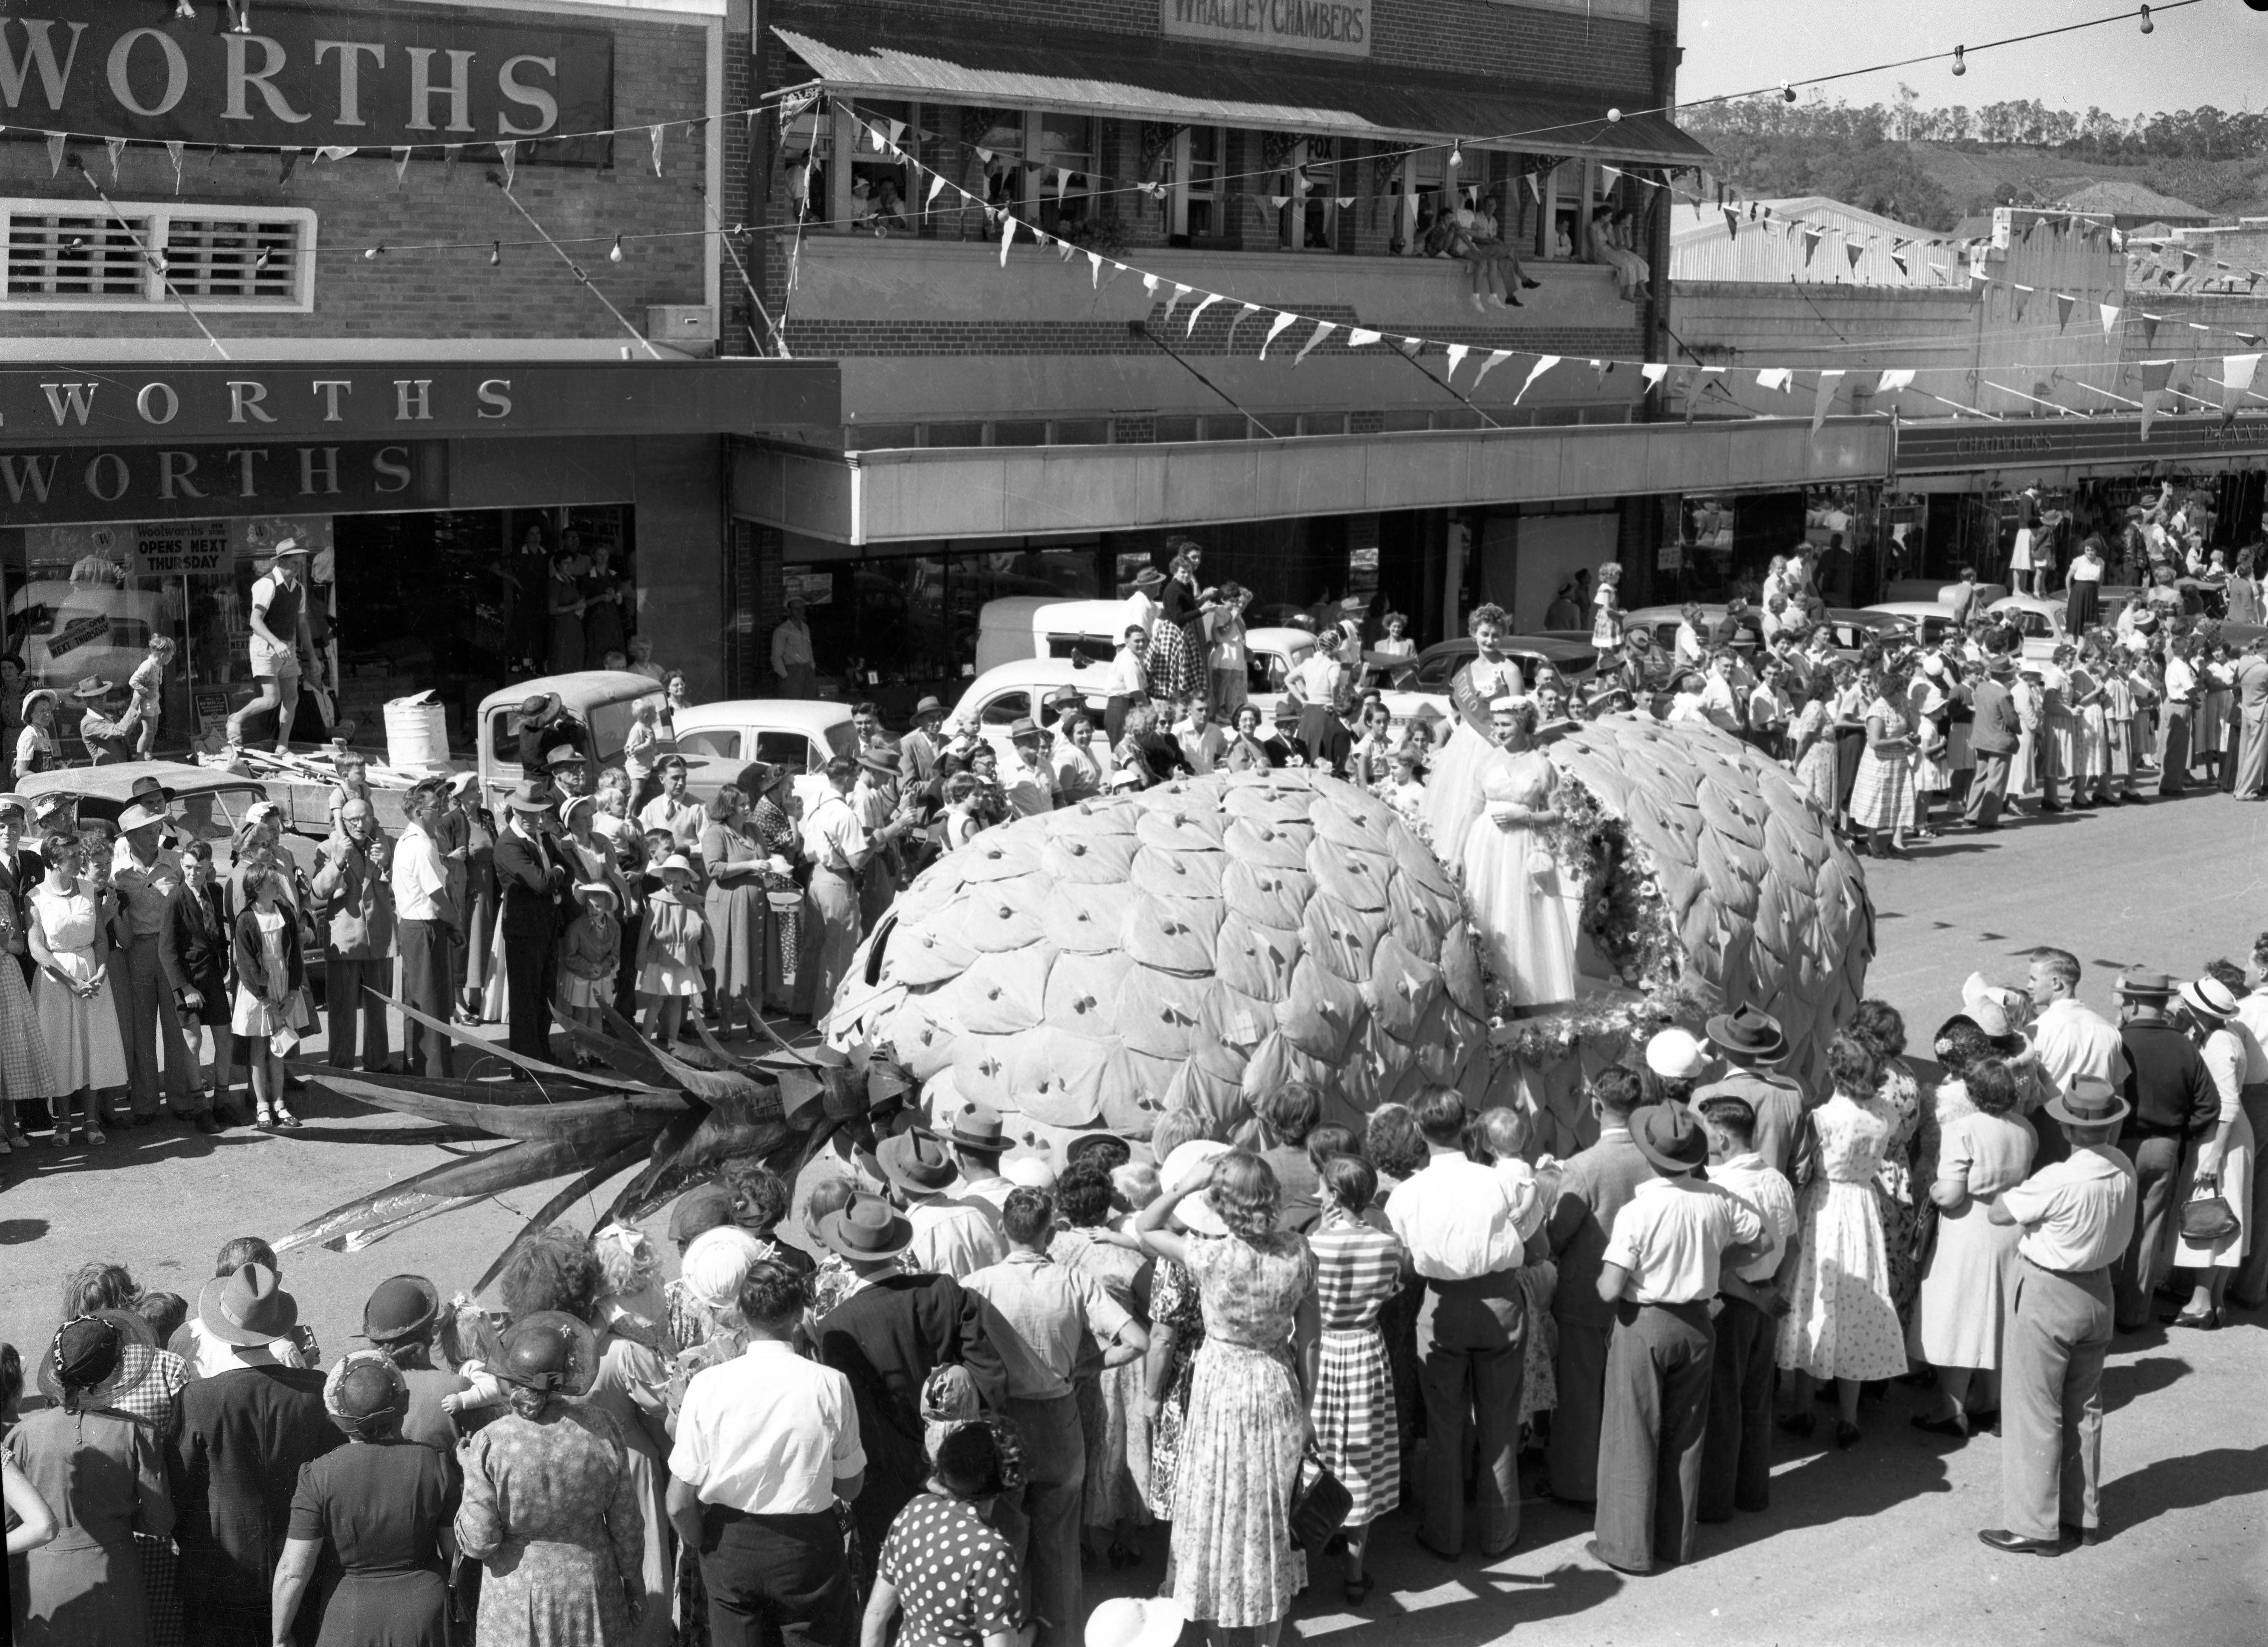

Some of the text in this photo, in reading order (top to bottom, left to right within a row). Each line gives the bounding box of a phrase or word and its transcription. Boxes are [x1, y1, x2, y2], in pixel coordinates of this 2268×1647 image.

[1271, 0, 1363, 43] CHAMBERS
[0, 17, 558, 135] WORTHS
[1307, 135, 1332, 159] FOX
[0, 379, 512, 426] WORTHS
[0, 446, 411, 503] WORTHS
[137, 523, 203, 537] Woolworths
[139, 539, 227, 554] OPENS NEXT
[147, 555, 219, 570] THURSDAY
[51, 622, 109, 658] NEXT THURSDAY
[230, 640, 249, 649] NEXT
